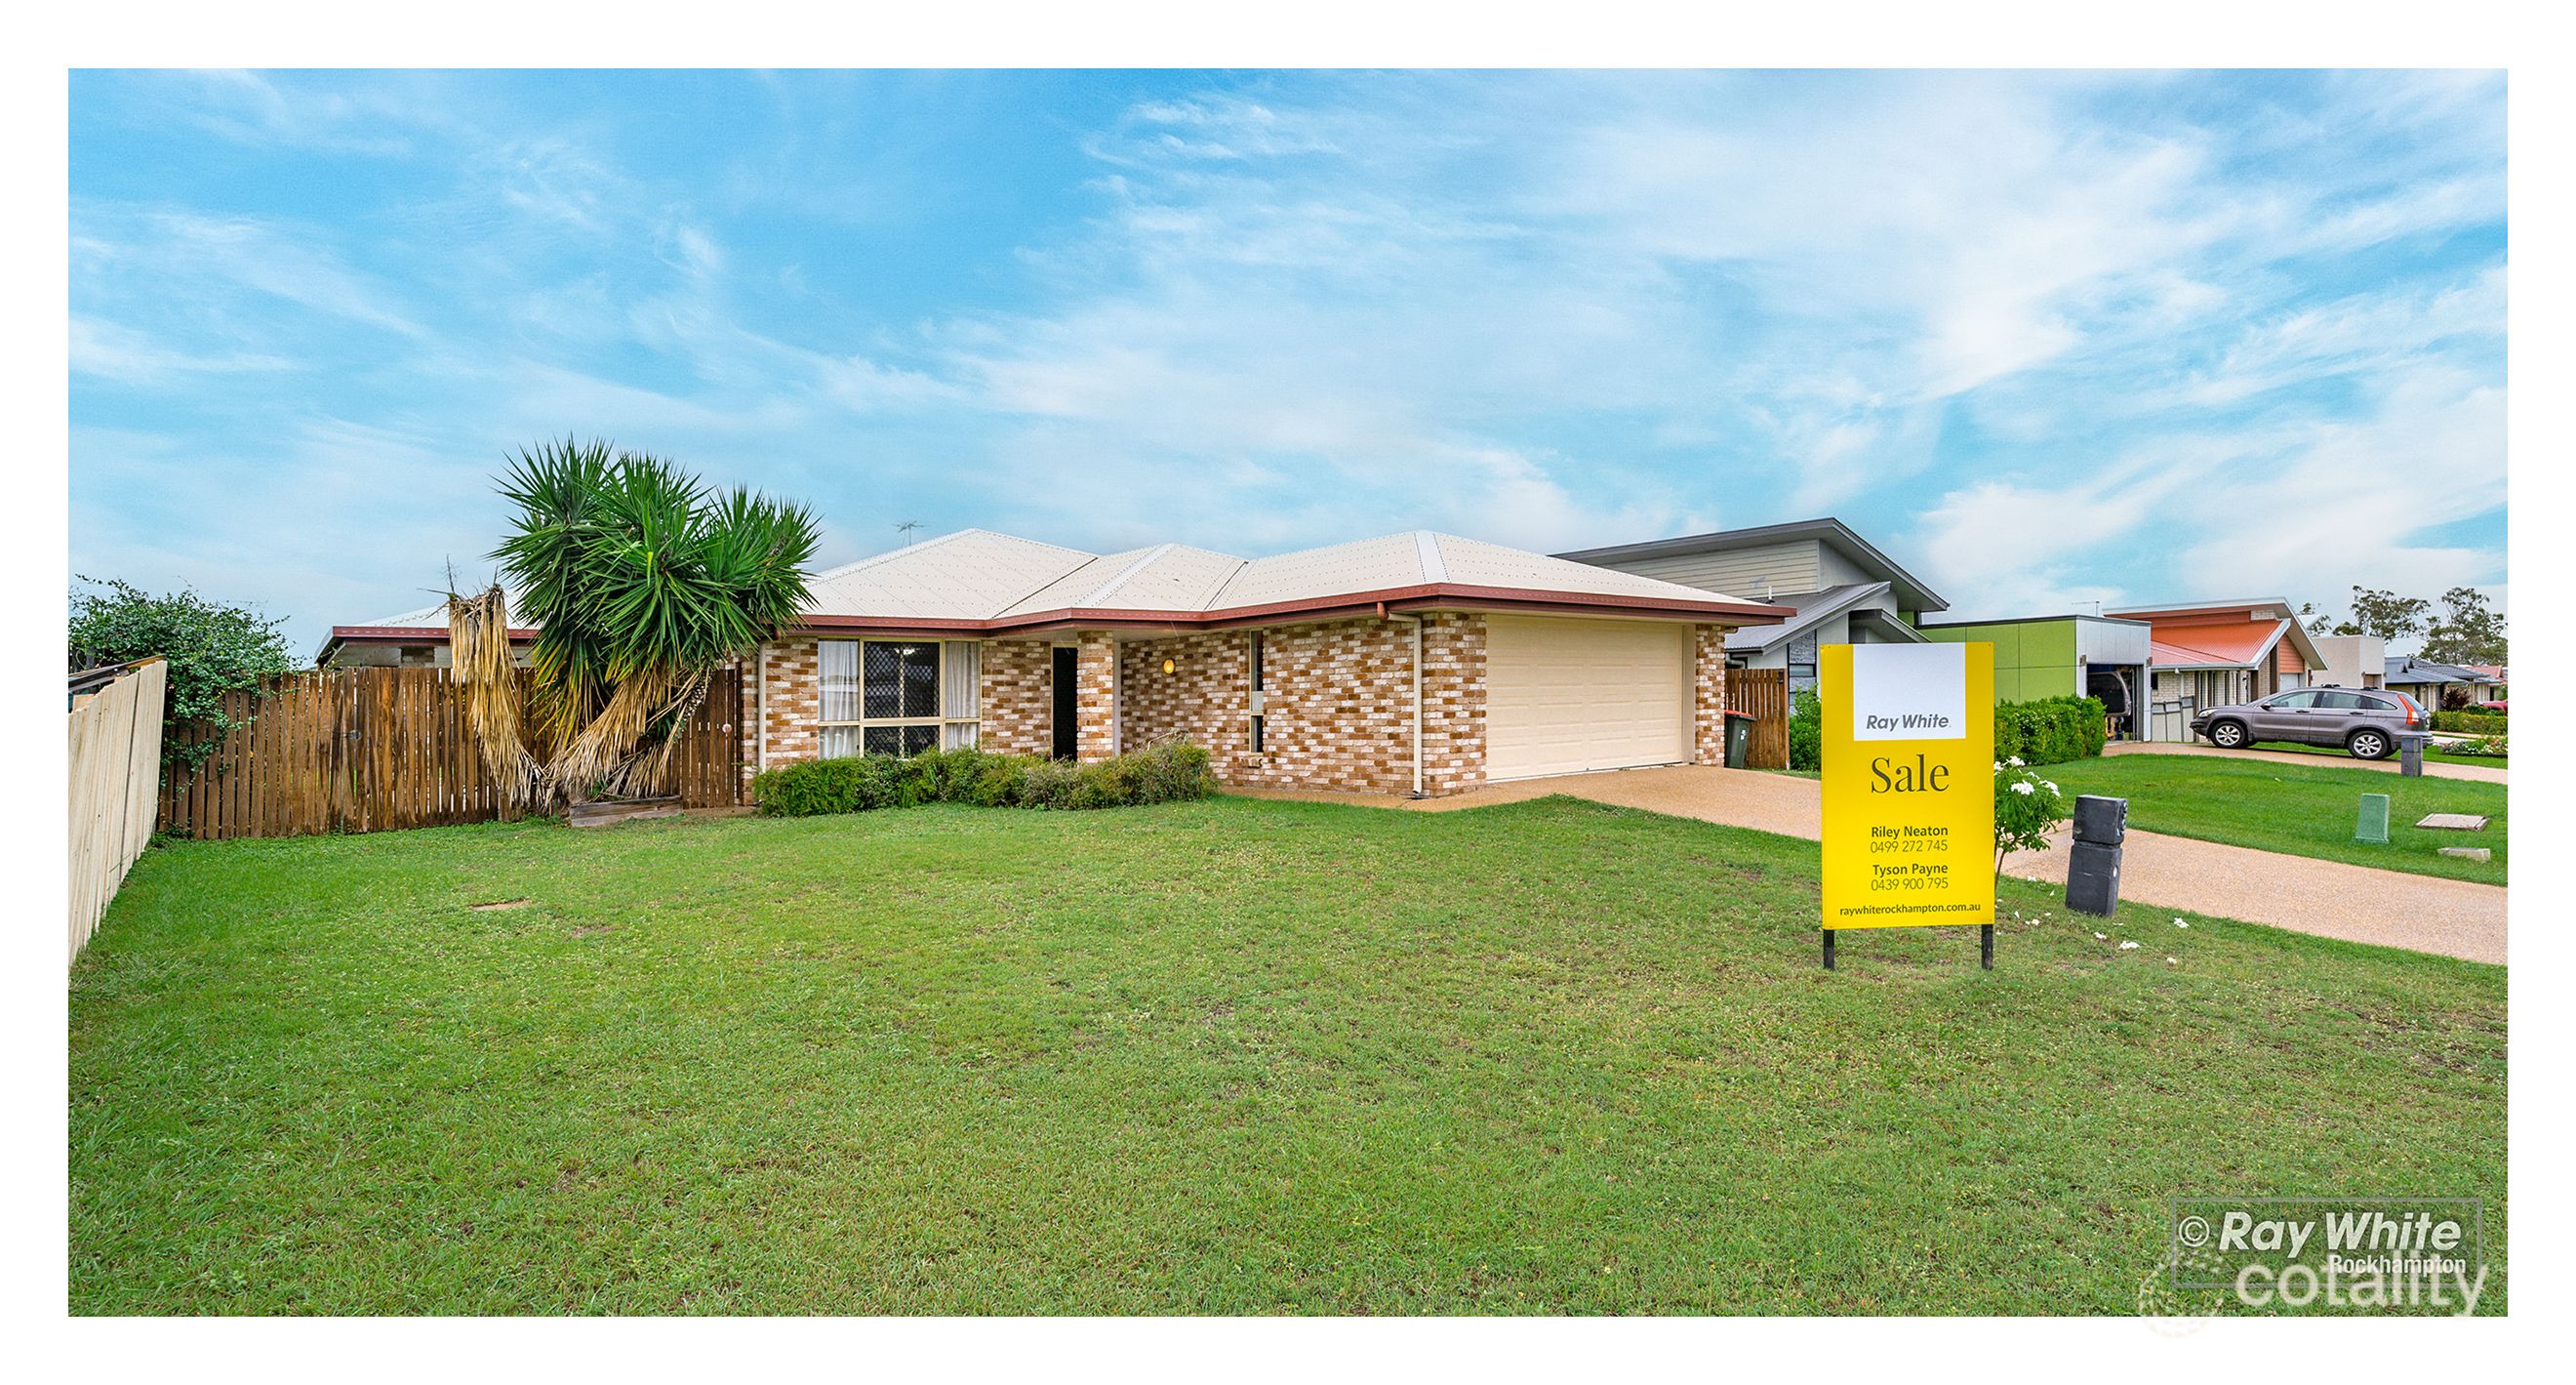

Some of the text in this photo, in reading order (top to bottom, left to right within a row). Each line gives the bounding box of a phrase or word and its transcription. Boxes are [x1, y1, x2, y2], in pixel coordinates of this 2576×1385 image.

[1867, 713, 1949, 732] Ray White
[1872, 754, 1949, 794] Sale
[1872, 826, 1948, 838] Riley Neaton
[1871, 839, 1948, 853] 0499 272 745
[1872, 863, 1948, 877] Tyson Payne
[1871, 877, 1948, 891] 0439 900 795
[1839, 903, 1981, 917] raywhiterockhampton.com.au
